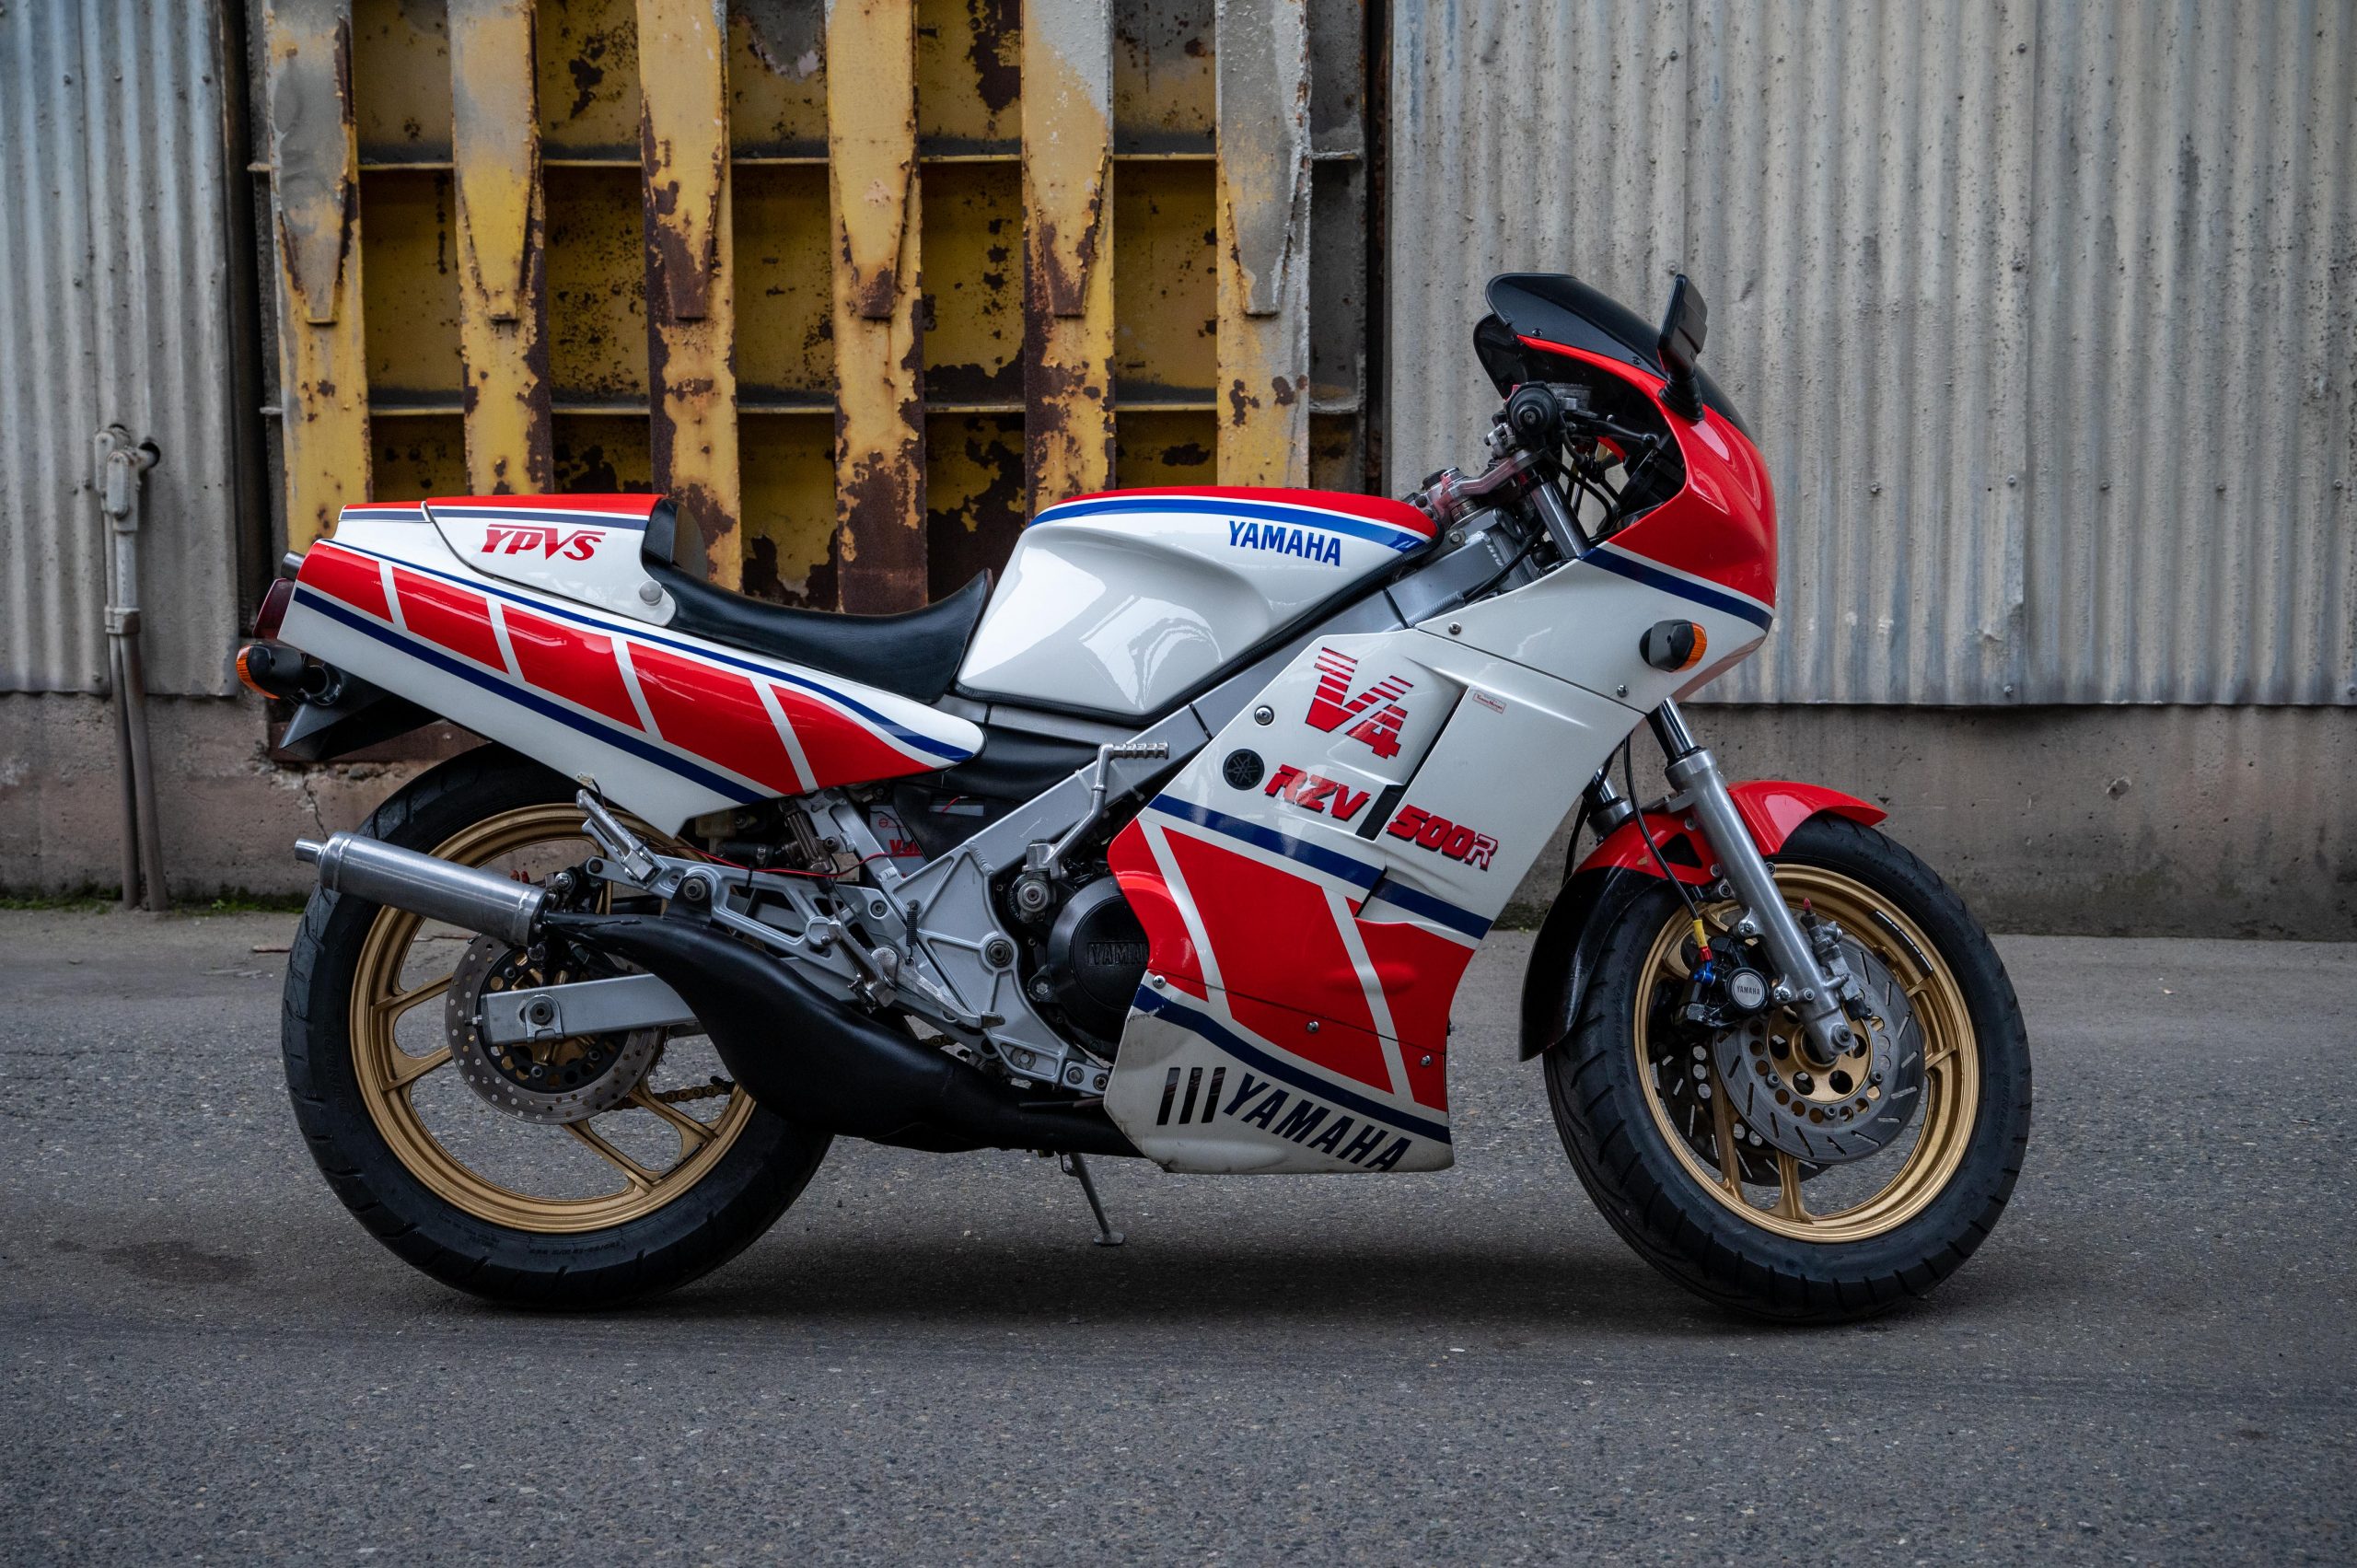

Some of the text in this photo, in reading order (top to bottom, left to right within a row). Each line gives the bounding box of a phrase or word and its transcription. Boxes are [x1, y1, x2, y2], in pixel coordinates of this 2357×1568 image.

[481, 524, 606, 561] YPVS
[1229, 520, 1341, 567] YAMAHA
[1305, 646, 1415, 760] V4
[1264, 763, 1499, 872] RZV 500R
[1736, 985, 1760, 995] YAMAHA
[1223, 1072, 1413, 1172] YAMAHA
